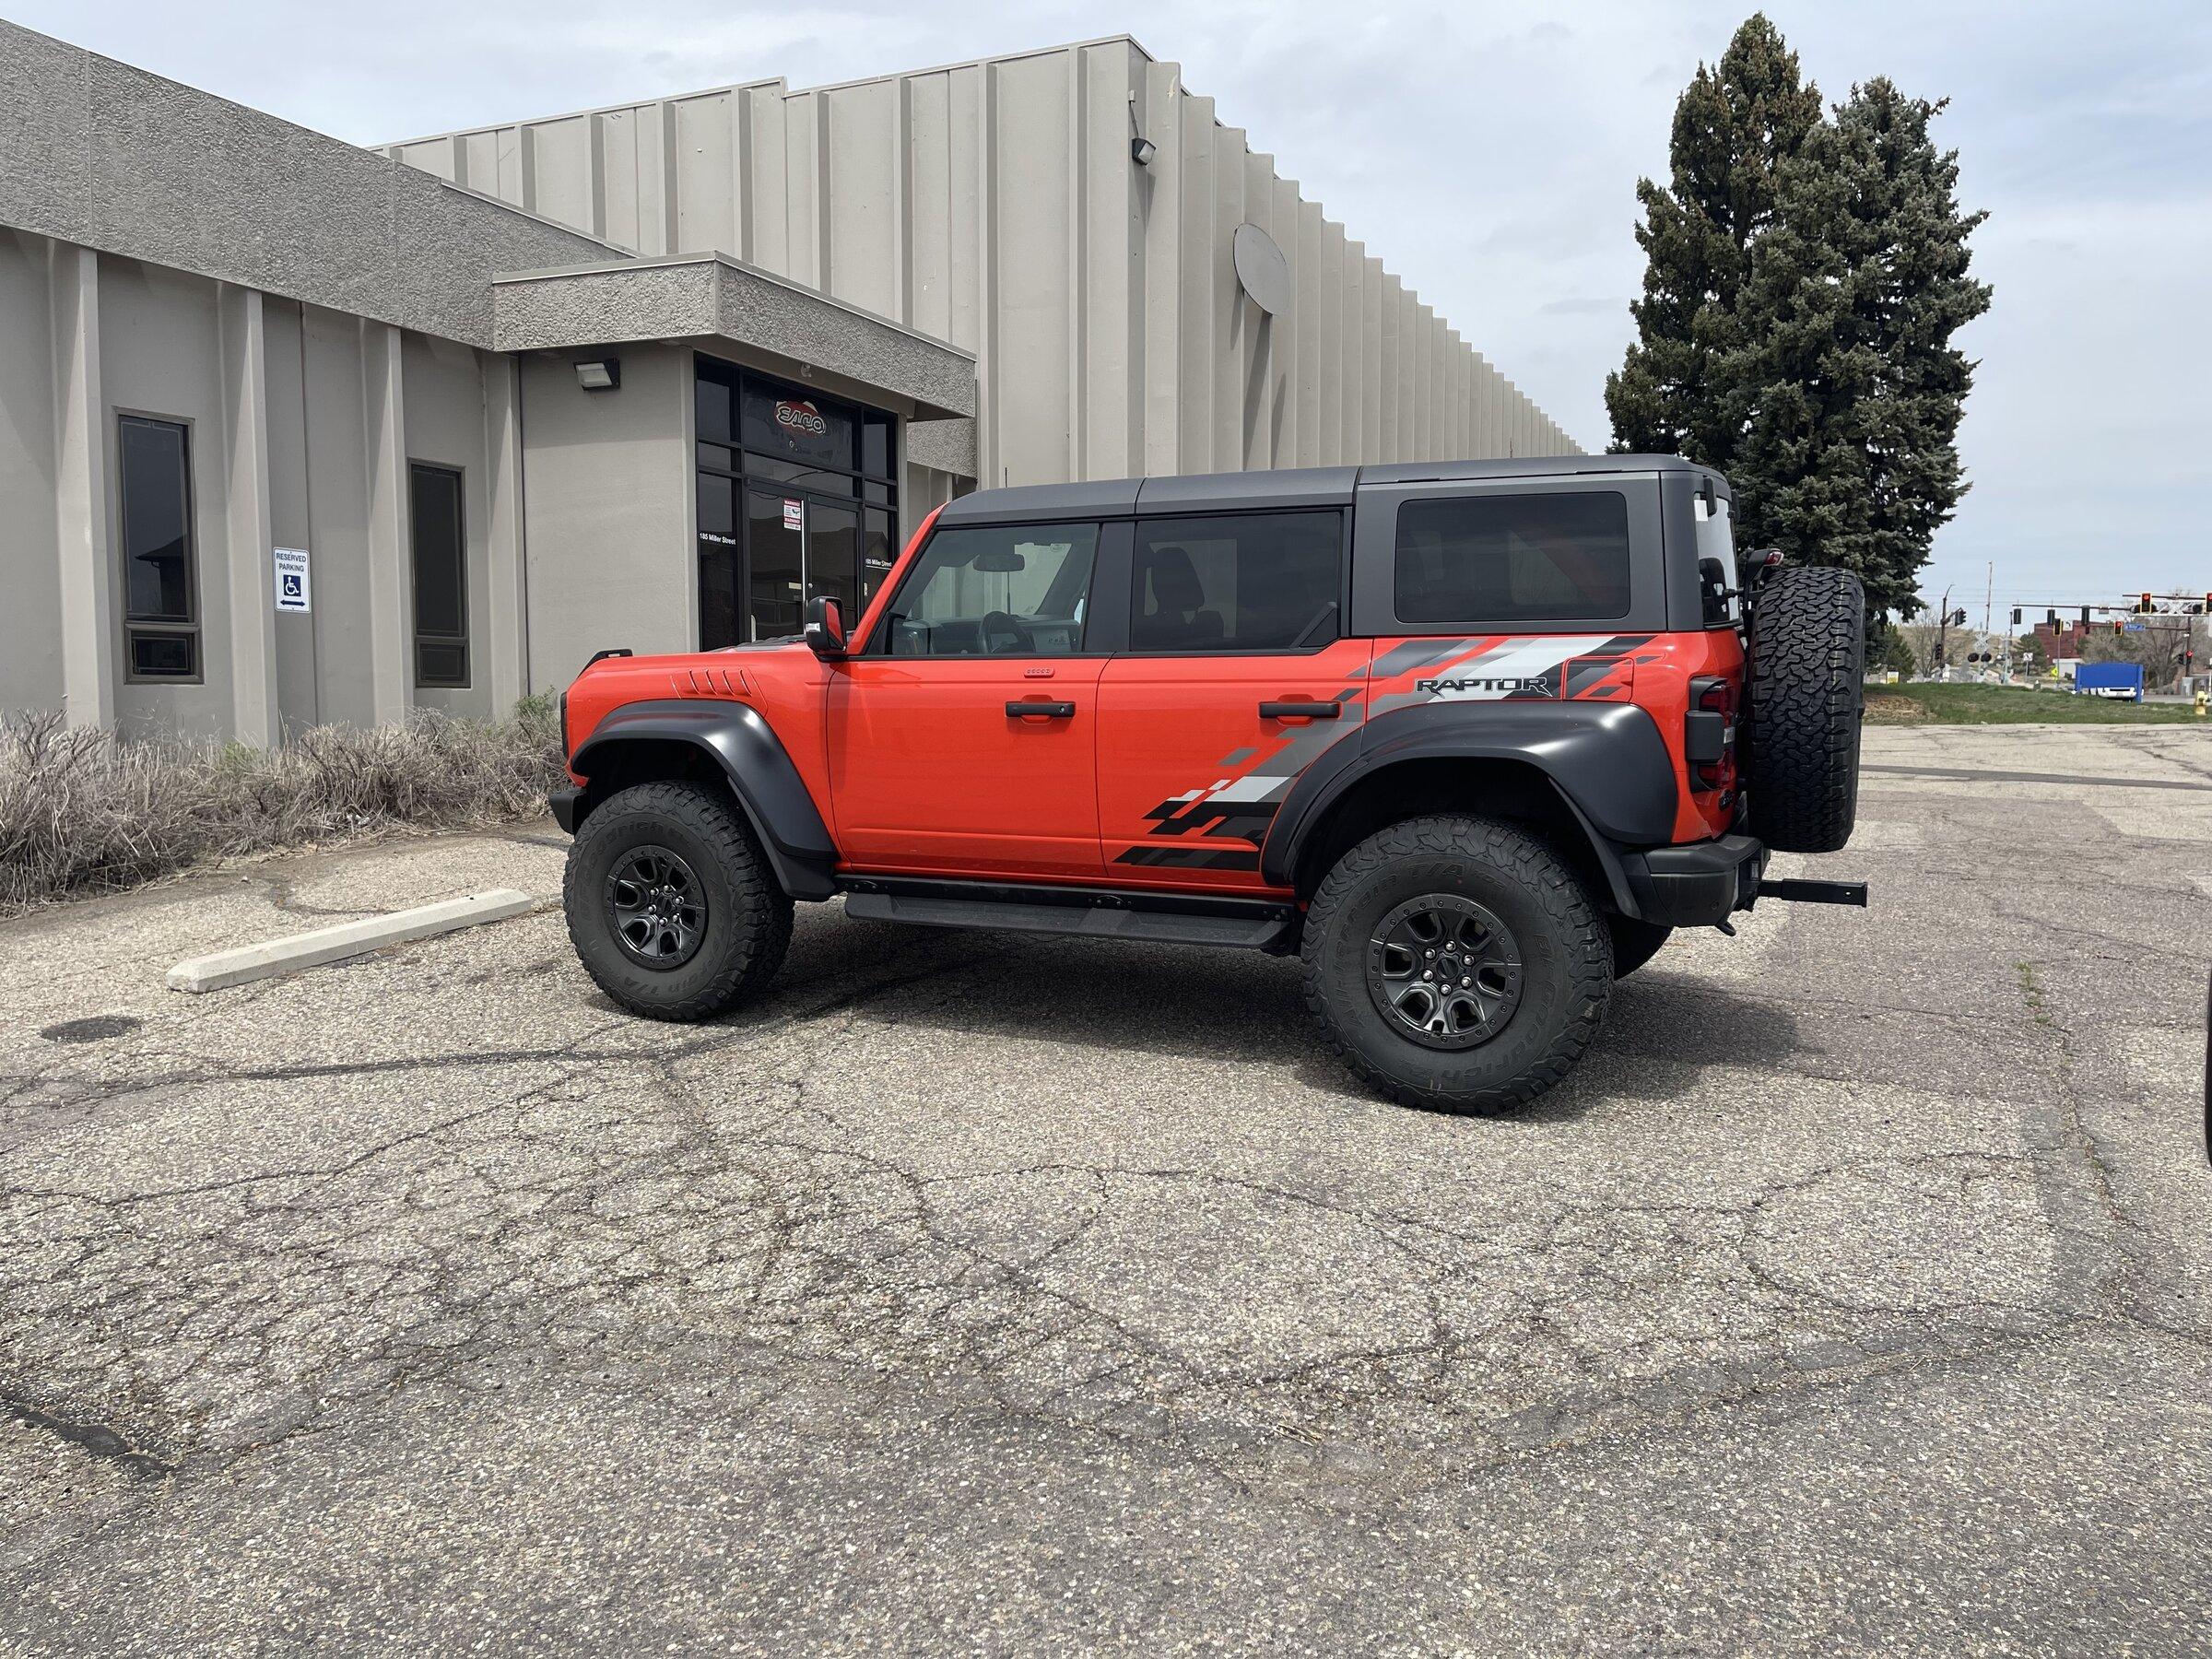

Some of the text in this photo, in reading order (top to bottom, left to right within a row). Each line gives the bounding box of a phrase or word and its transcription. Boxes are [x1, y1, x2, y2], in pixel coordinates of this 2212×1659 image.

[722, 535, 736, 545] Street
[276, 553, 306, 562] RESERVED
[278, 563, 304, 571] PARKING
[1415, 677, 1553, 698] RAPTOR
